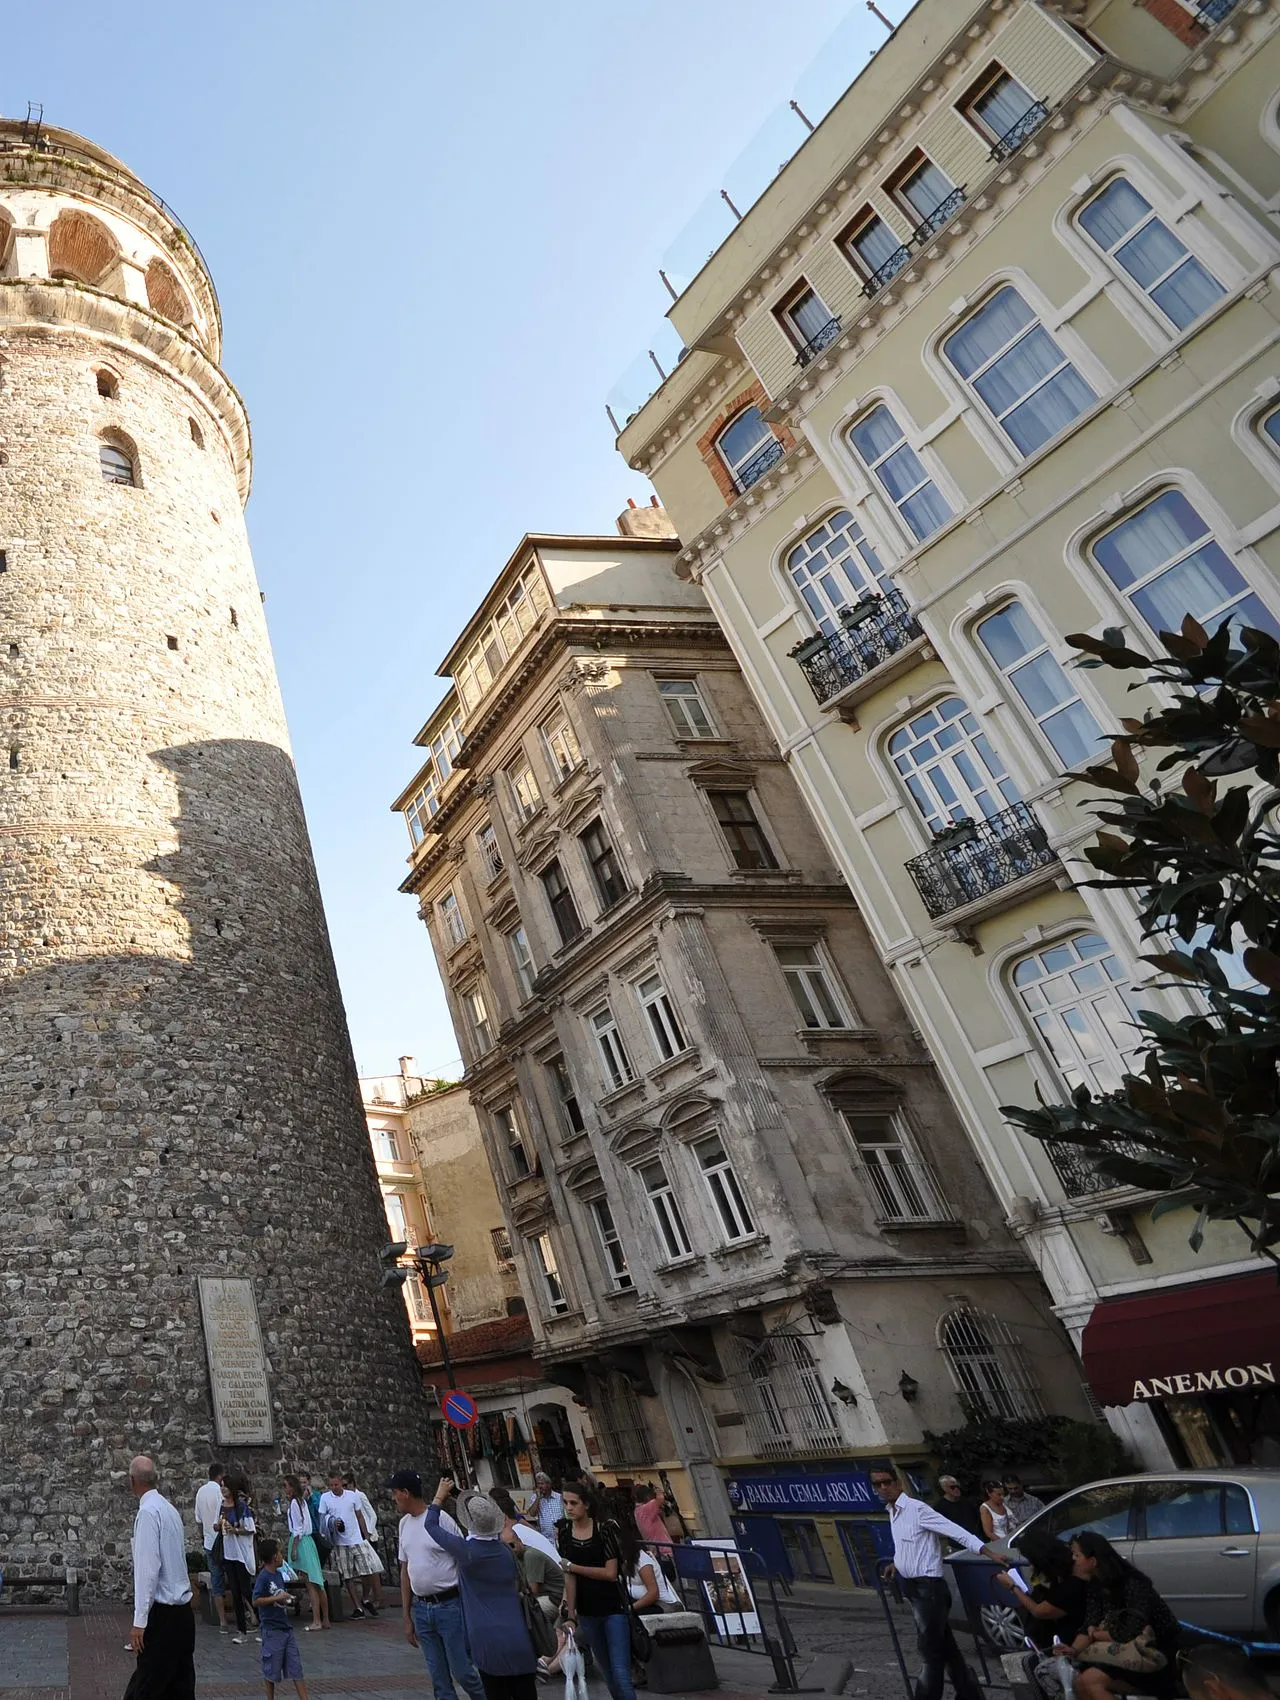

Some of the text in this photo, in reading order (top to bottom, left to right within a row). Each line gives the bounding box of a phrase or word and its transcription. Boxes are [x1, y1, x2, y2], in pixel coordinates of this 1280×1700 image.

[1132, 1362, 1276, 1399] ANEMON
[746, 1484, 790, 1504] BAKKAL
[789, 1483, 826, 1503] CEMAL
[826, 1481, 871, 1502] ARSLAN
